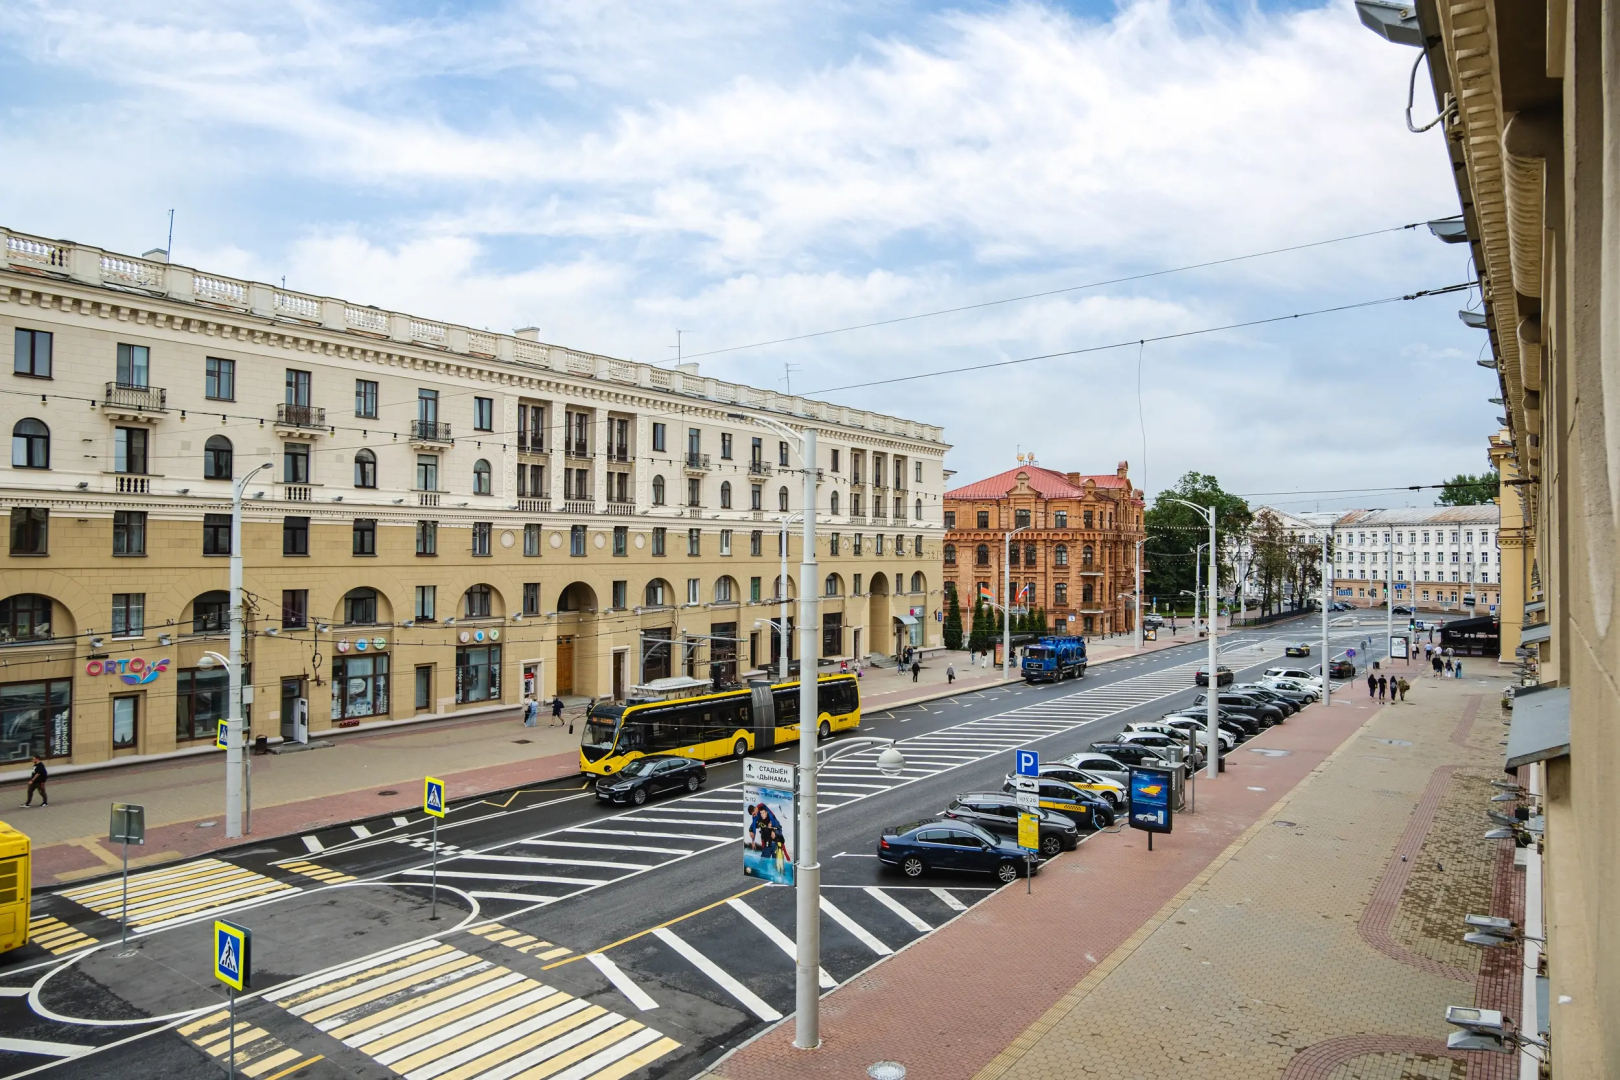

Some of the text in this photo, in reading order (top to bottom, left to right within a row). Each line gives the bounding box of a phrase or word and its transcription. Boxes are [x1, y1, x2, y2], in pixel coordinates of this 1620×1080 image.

[86, 658, 145, 676] ORTO
[53, 713, 61, 755] Химчистка
[1022, 752, 1034, 772] P
